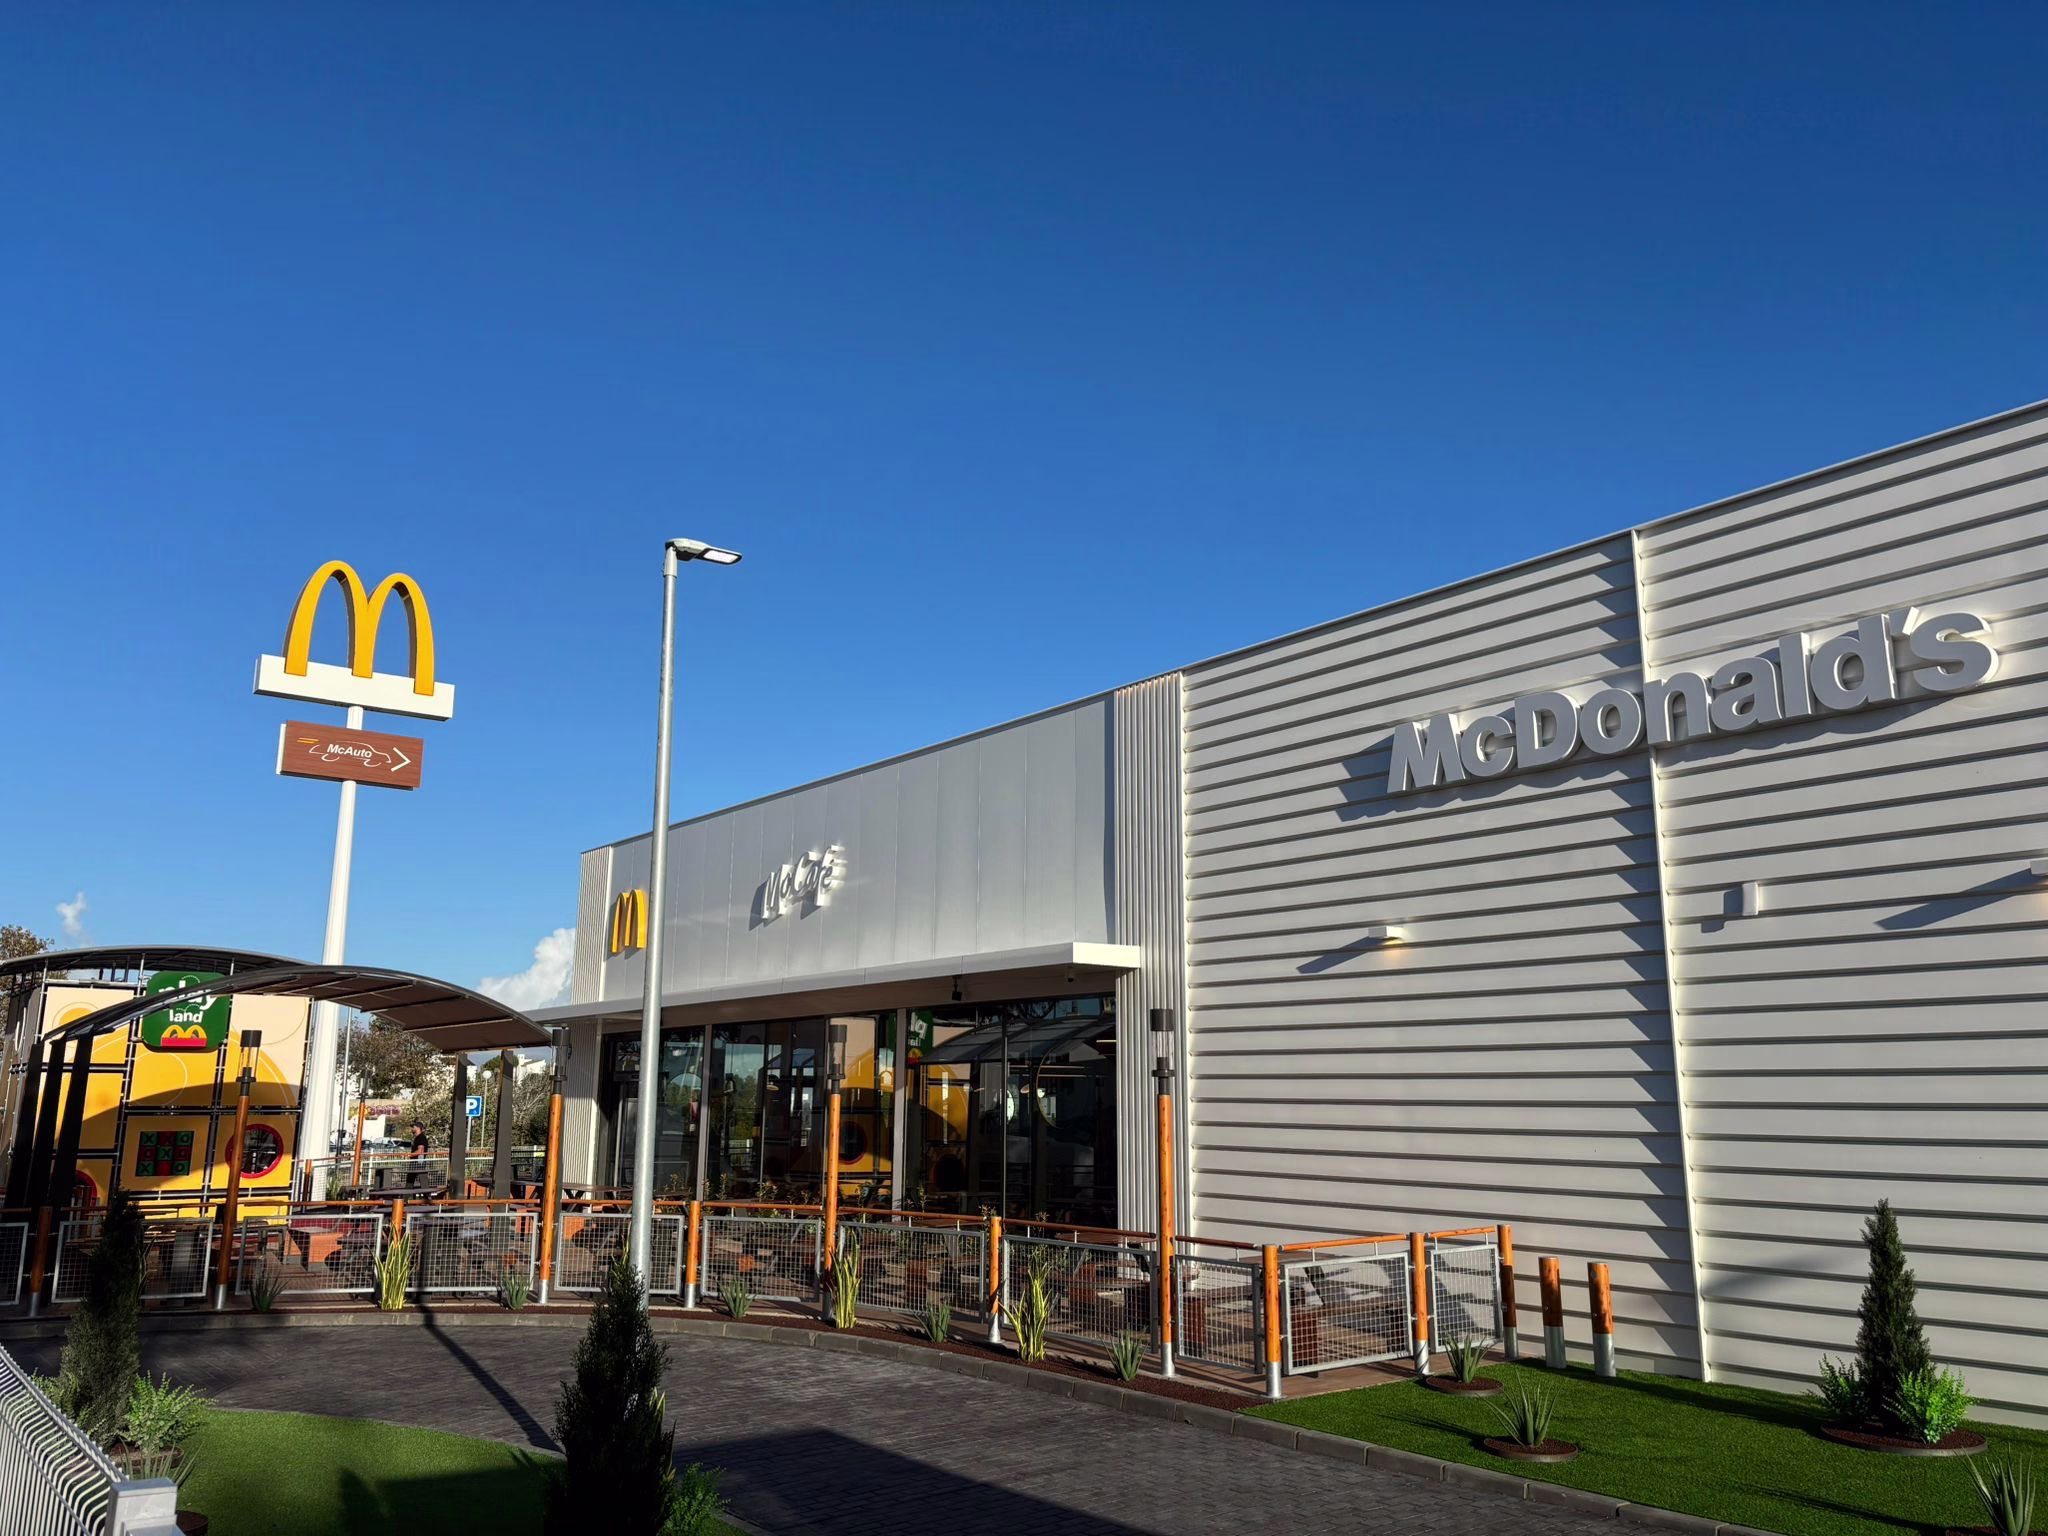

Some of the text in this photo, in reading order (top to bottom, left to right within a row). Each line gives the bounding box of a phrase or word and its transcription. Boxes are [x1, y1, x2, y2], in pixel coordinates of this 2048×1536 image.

[1387, 606, 2000, 794] McDonald's
[326, 743, 373, 758] McAuto
[169, 1009, 204, 1023] land
[466, 1098, 478, 1114] P
